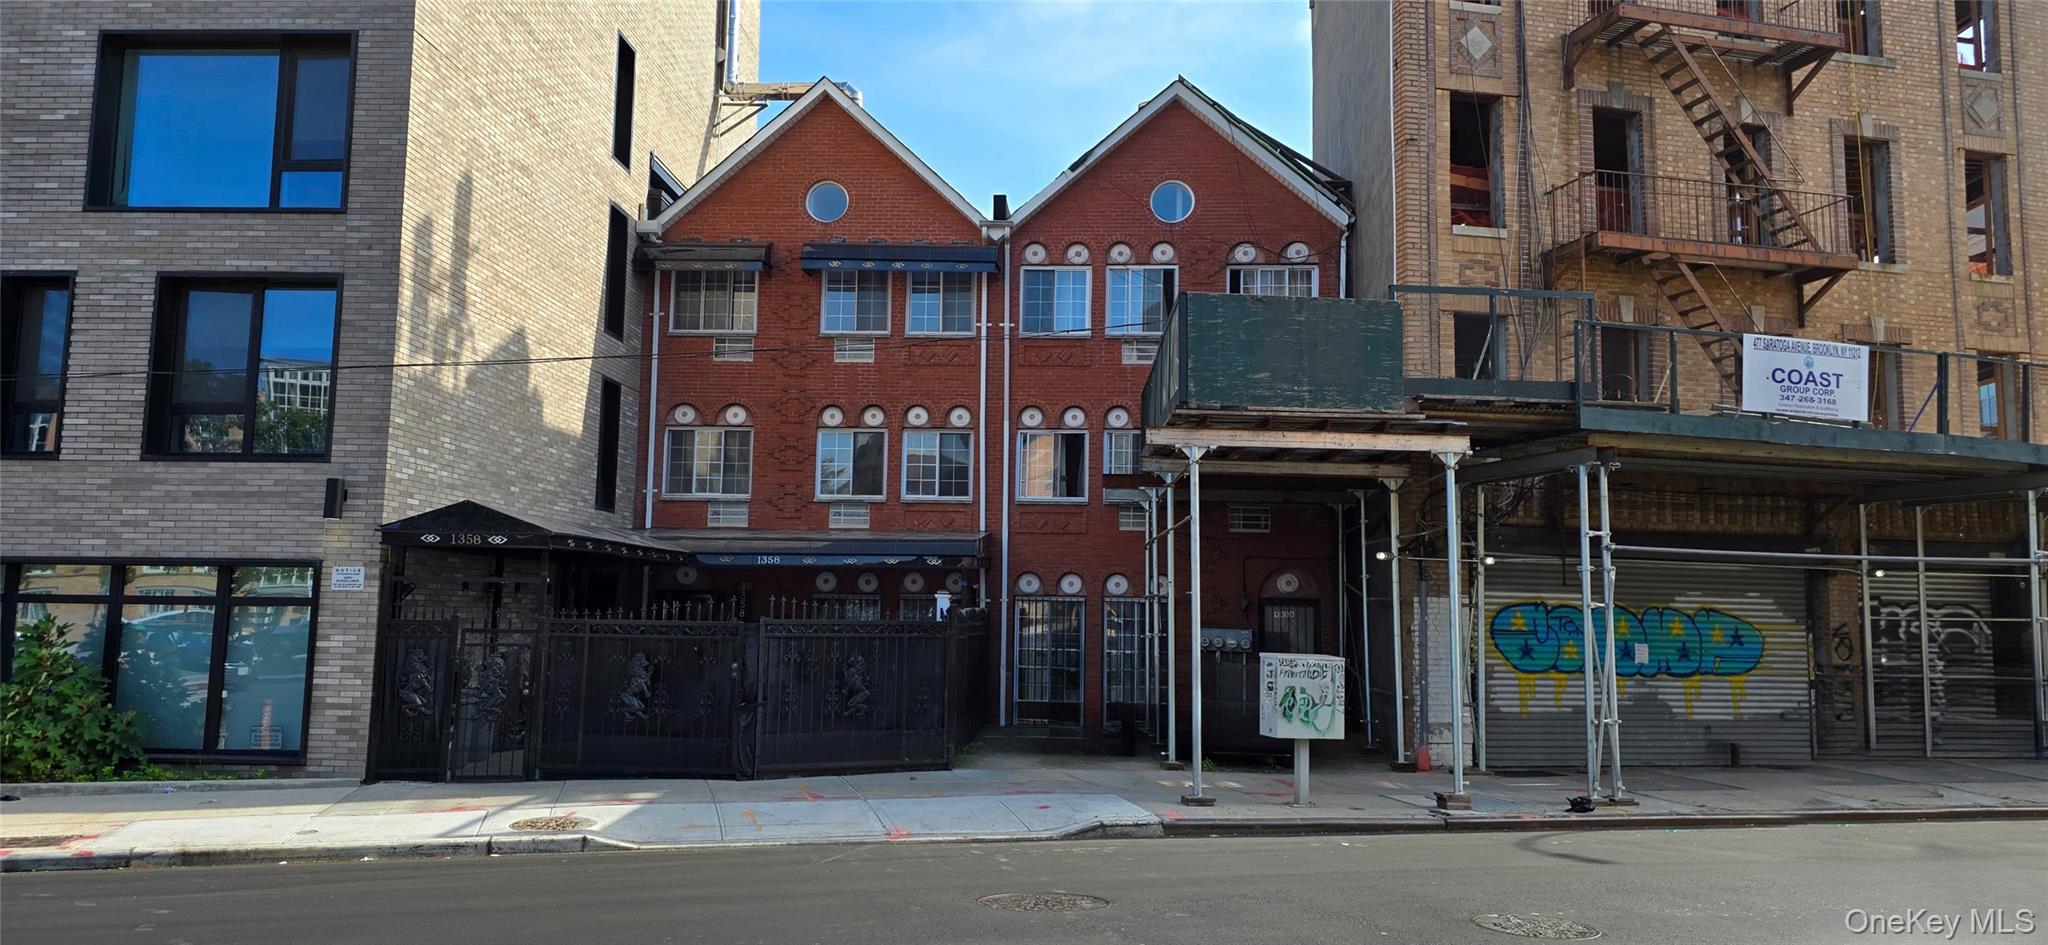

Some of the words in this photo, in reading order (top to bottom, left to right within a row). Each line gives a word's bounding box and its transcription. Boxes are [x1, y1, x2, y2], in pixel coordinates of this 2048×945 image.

[1753, 337, 1762, 349] 477
[1763, 338, 1790, 352] SARATOGA
[1840, 345, 1847, 357] NY
[1771, 367, 1844, 389] COAST
[1780, 385, 1811, 395] GROUP
[1812, 387, 1836, 398] CORP.
[450, 533, 481, 545] 1358
[757, 555, 780, 565] 1358
